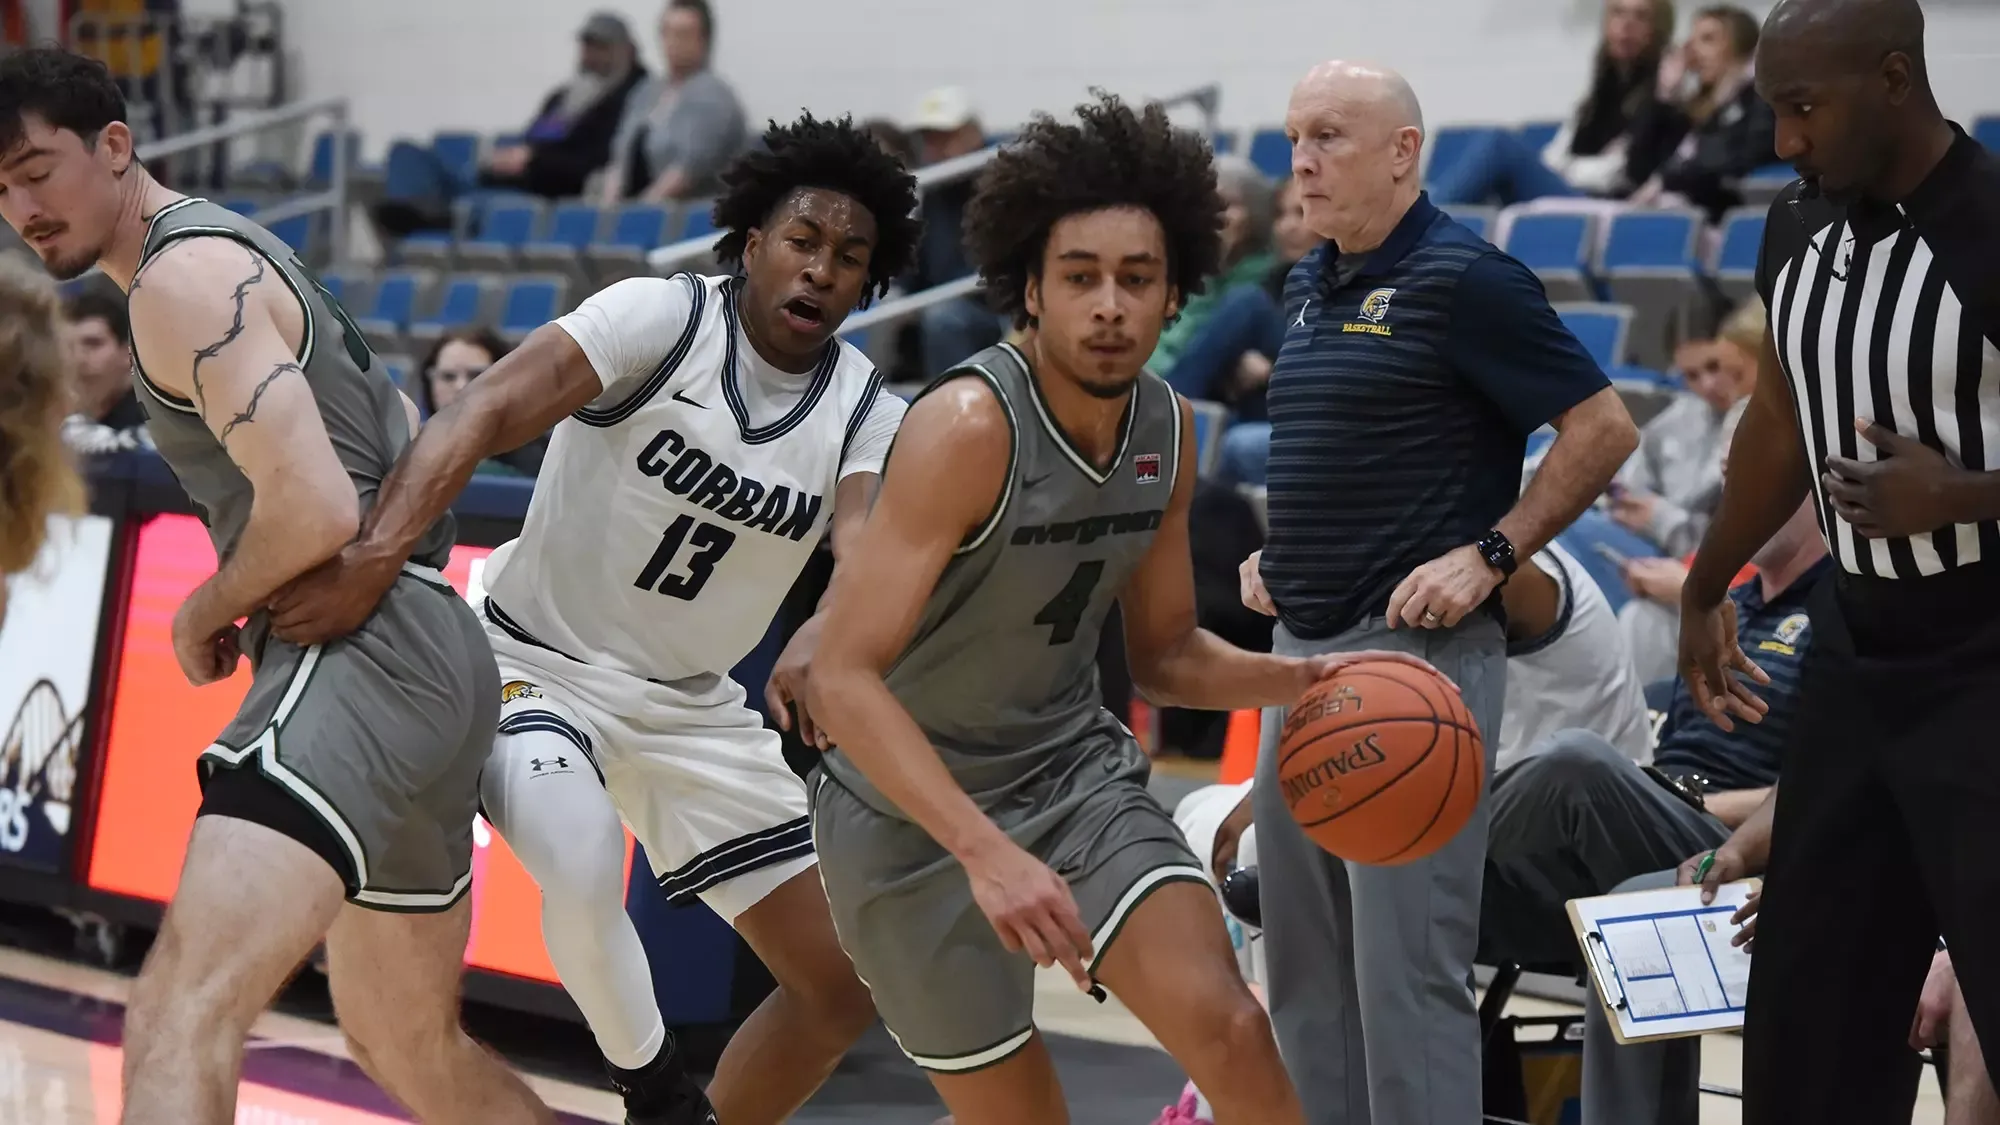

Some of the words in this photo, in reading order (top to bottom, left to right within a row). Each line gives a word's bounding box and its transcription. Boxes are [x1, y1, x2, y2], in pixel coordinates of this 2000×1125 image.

[1342, 323, 1392, 336] BASKETBALL
[637, 429, 822, 542] CORBAN
[633, 513, 737, 602] 13
[1034, 560, 1106, 646] 4
[1280, 696, 1362, 746] LEGAC
